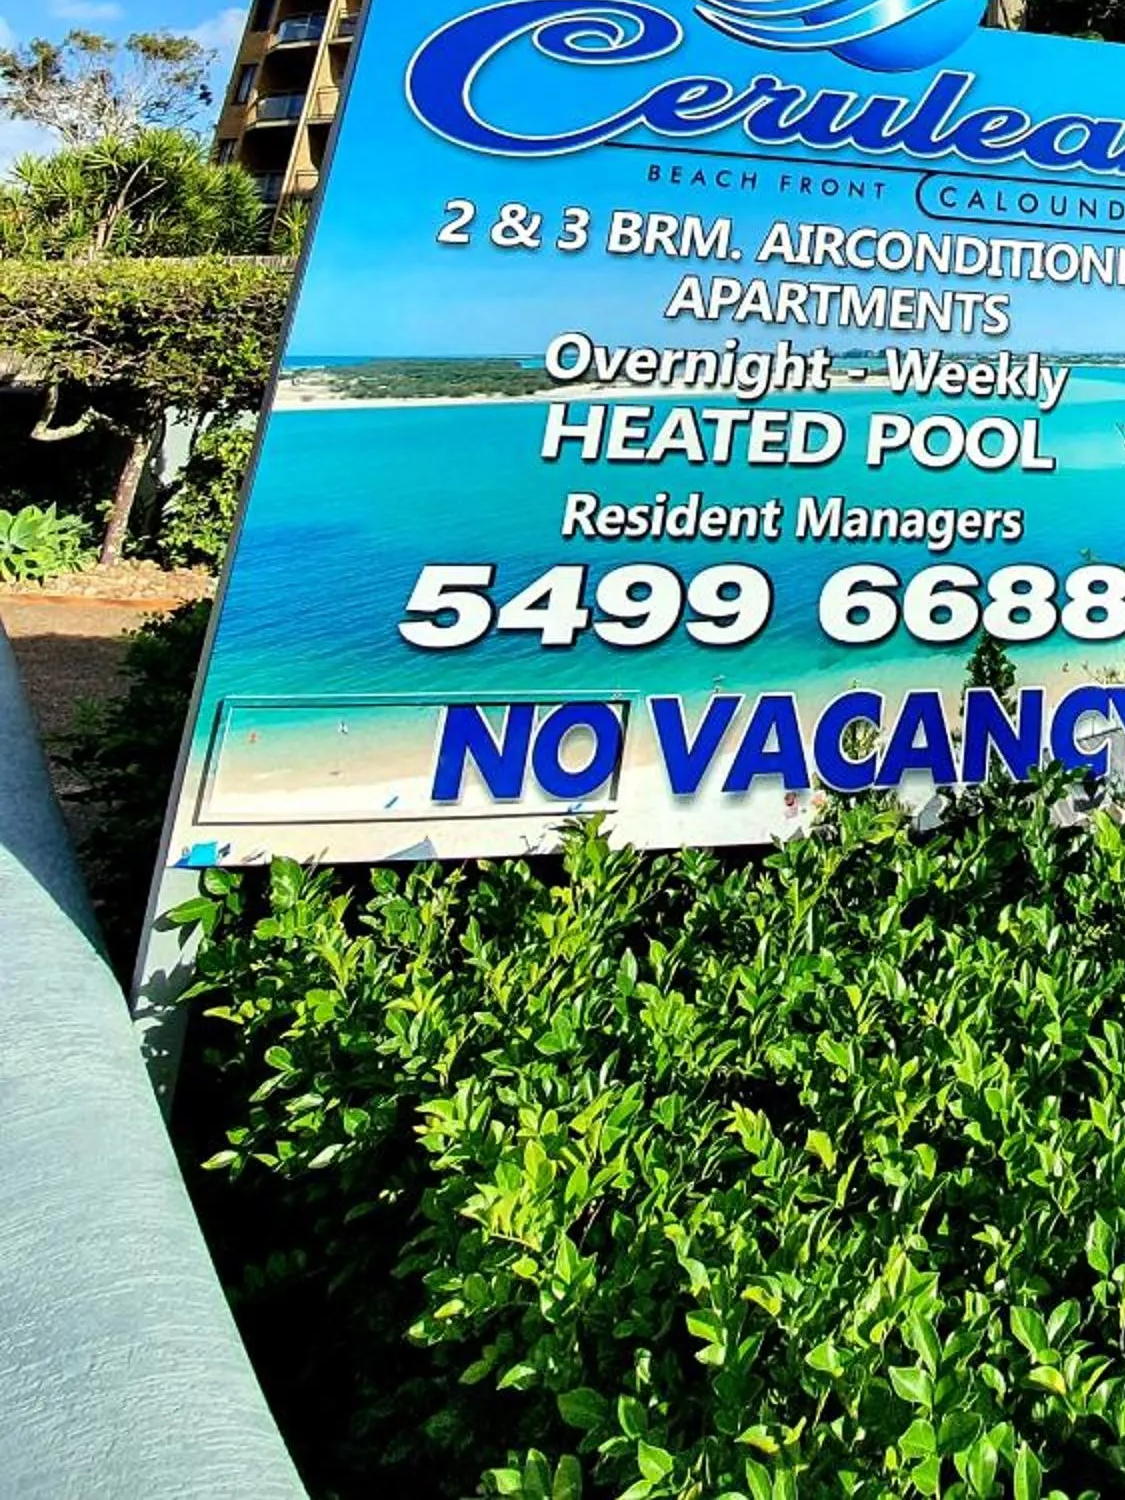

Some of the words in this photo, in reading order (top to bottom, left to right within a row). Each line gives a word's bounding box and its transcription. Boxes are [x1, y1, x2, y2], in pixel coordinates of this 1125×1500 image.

[647, 163, 758, 191] BEACH
[780, 175, 886, 201] FRONT
[436, 197, 476, 245] 2
[490, 201, 542, 249] &
[556, 205, 591, 252] 3
[607, 209, 743, 262] BRM.
[665, 274, 1011, 336] APARTMENTS
[544, 331, 832, 401] Overnight
[885, 348, 1071, 412] Weekly
[540, 402, 844, 467] HEATED
[865, 413, 1057, 471] POOL
[561, 492, 784, 542] Resident
[795, 496, 1024, 550] Managers
[397, 562, 773, 650] 5499
[430, 698, 629, 804] NO
